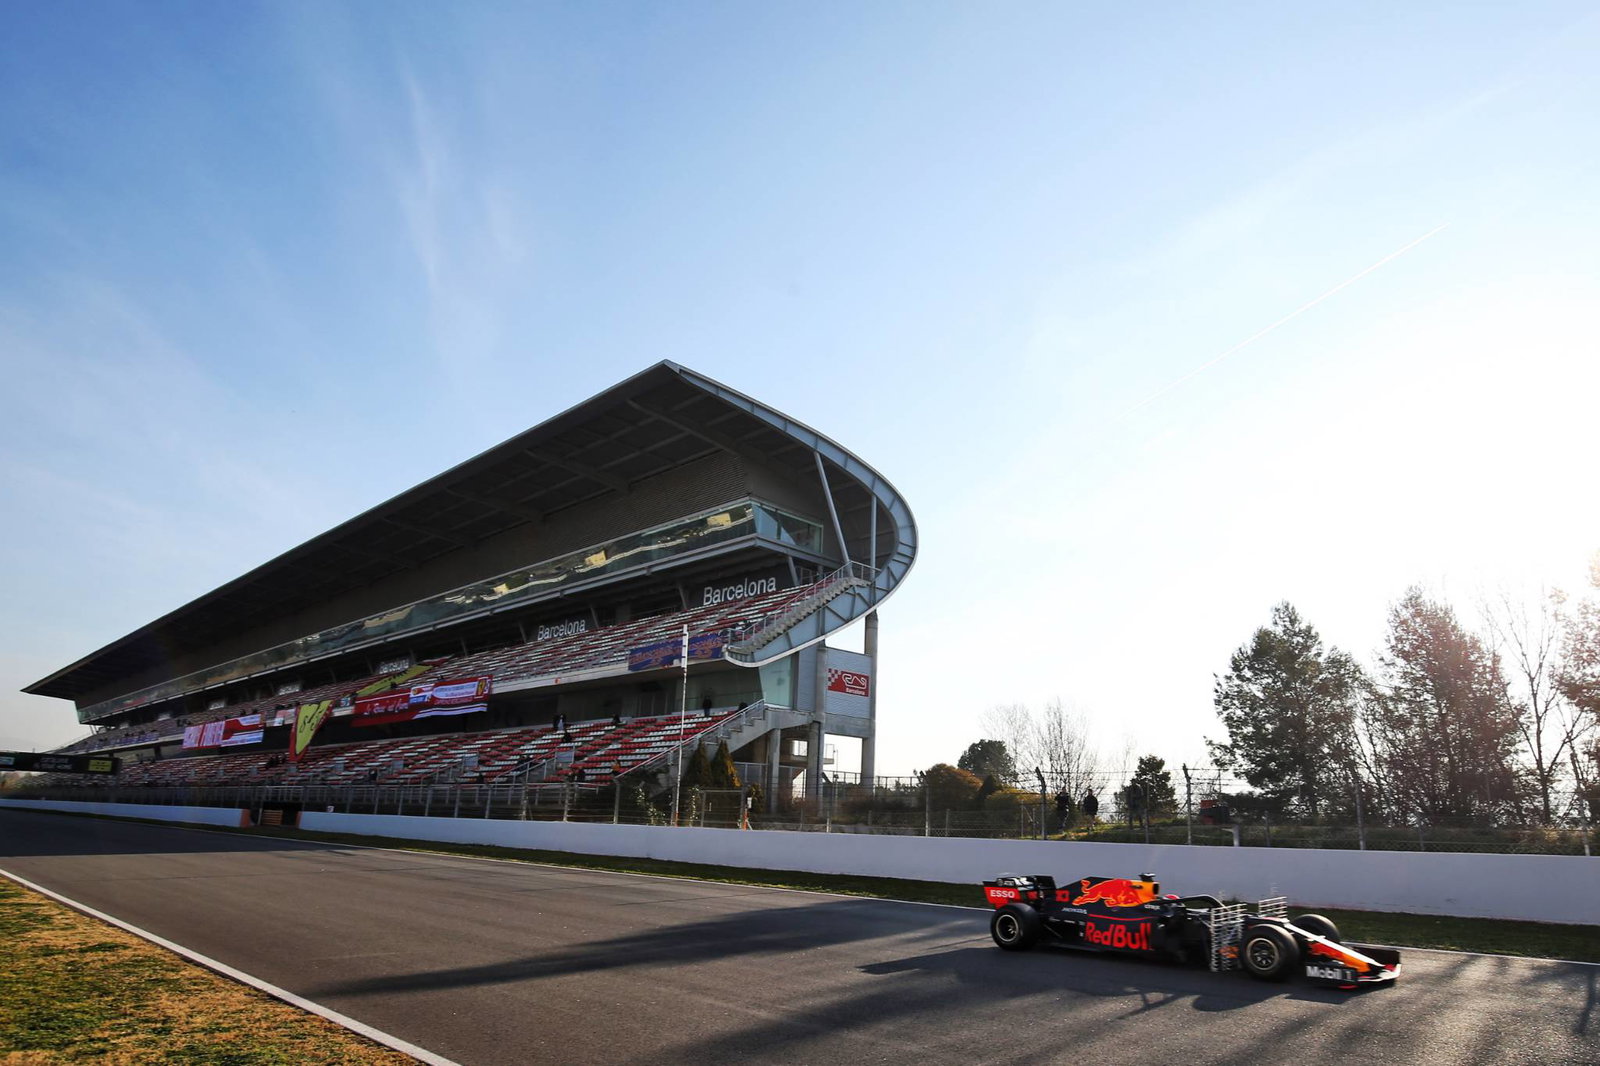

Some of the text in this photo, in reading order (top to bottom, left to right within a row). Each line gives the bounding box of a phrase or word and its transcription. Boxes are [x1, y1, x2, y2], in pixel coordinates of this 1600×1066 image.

[703, 577, 776, 606] Barcelona
[537, 619, 586, 640] Barcelona
[990, 889, 1015, 898] ESSO
[1306, 965, 1343, 980] Mobil
